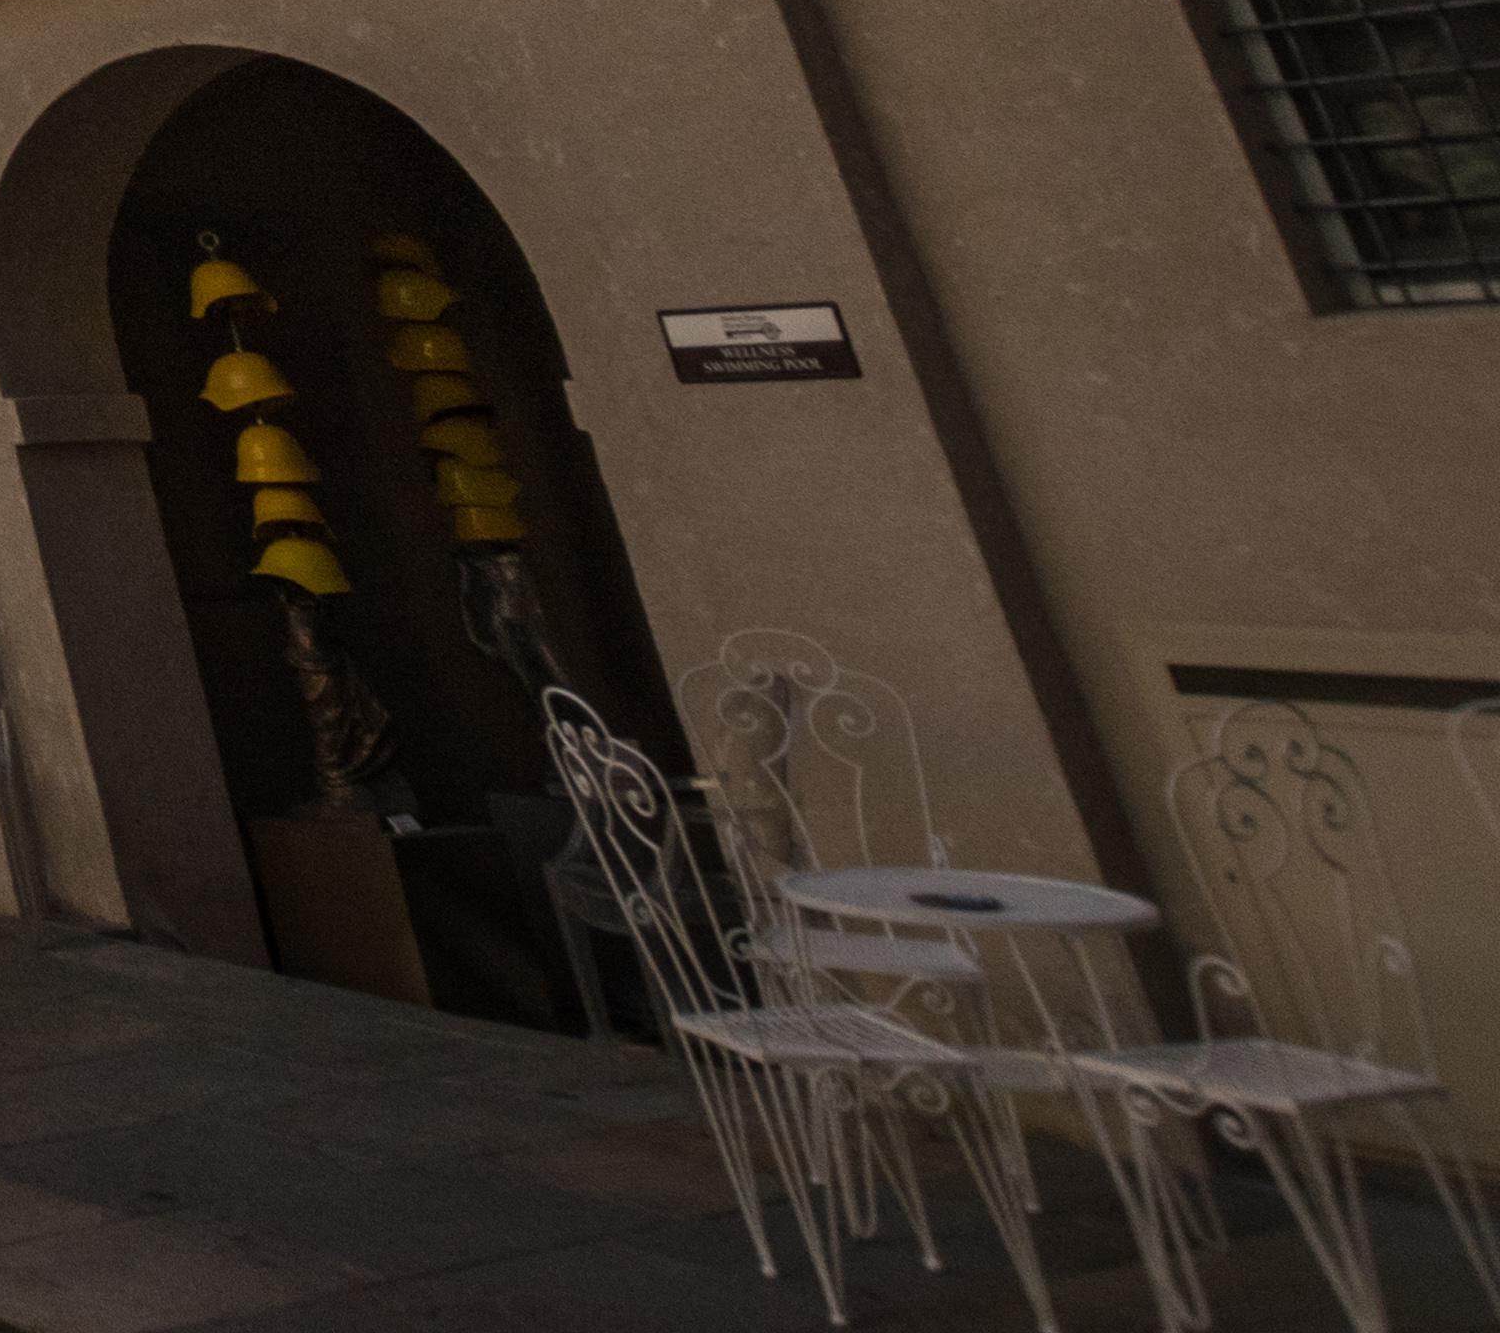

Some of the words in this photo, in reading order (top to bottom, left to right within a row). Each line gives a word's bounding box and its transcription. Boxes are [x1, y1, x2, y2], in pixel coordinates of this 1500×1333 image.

[720, 346, 796, 358] WELLNESS
[703, 360, 780, 372] SWIMMING
[781, 357, 823, 370] POOL
